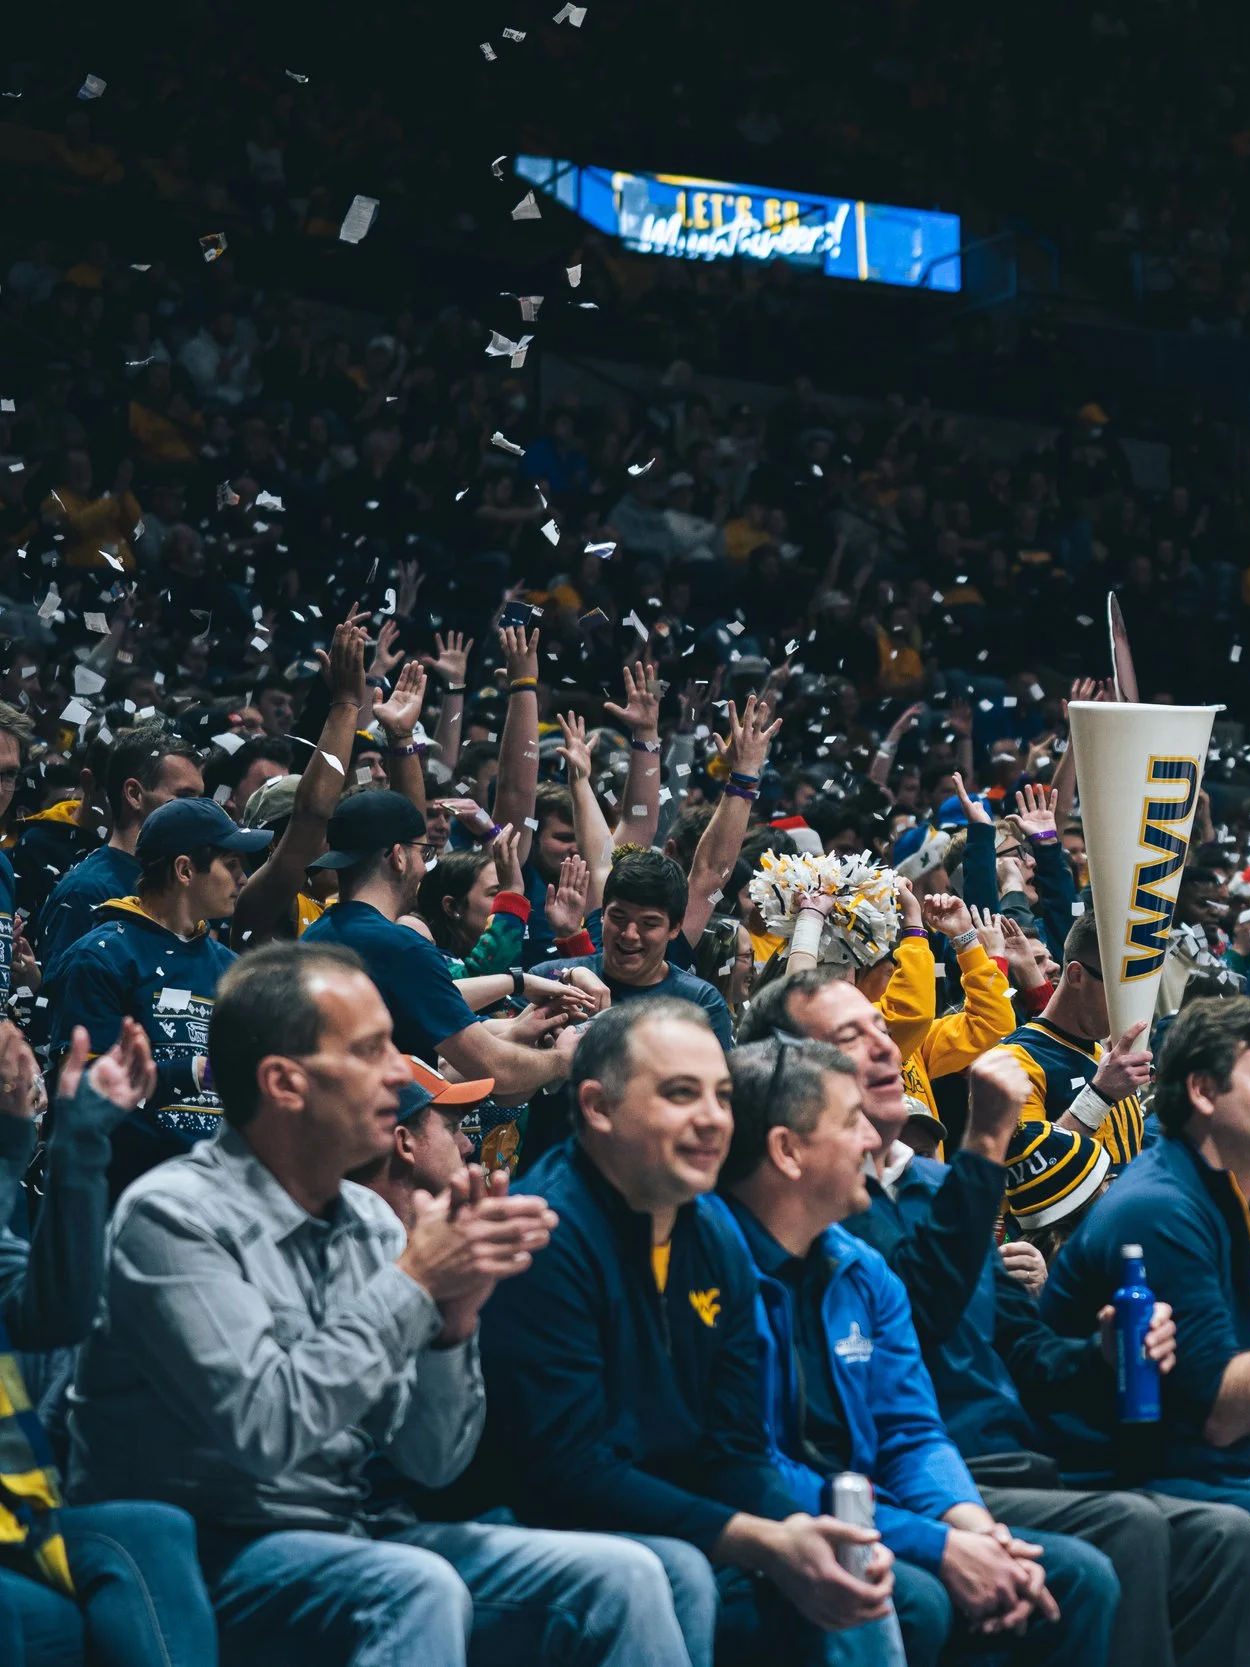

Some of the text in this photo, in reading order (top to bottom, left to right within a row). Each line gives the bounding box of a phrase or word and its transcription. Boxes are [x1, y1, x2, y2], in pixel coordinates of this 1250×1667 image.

[675, 191, 752, 230] LET'S
[1119, 755, 1200, 984] WVU
[1004, 1150, 1049, 1188] VU
